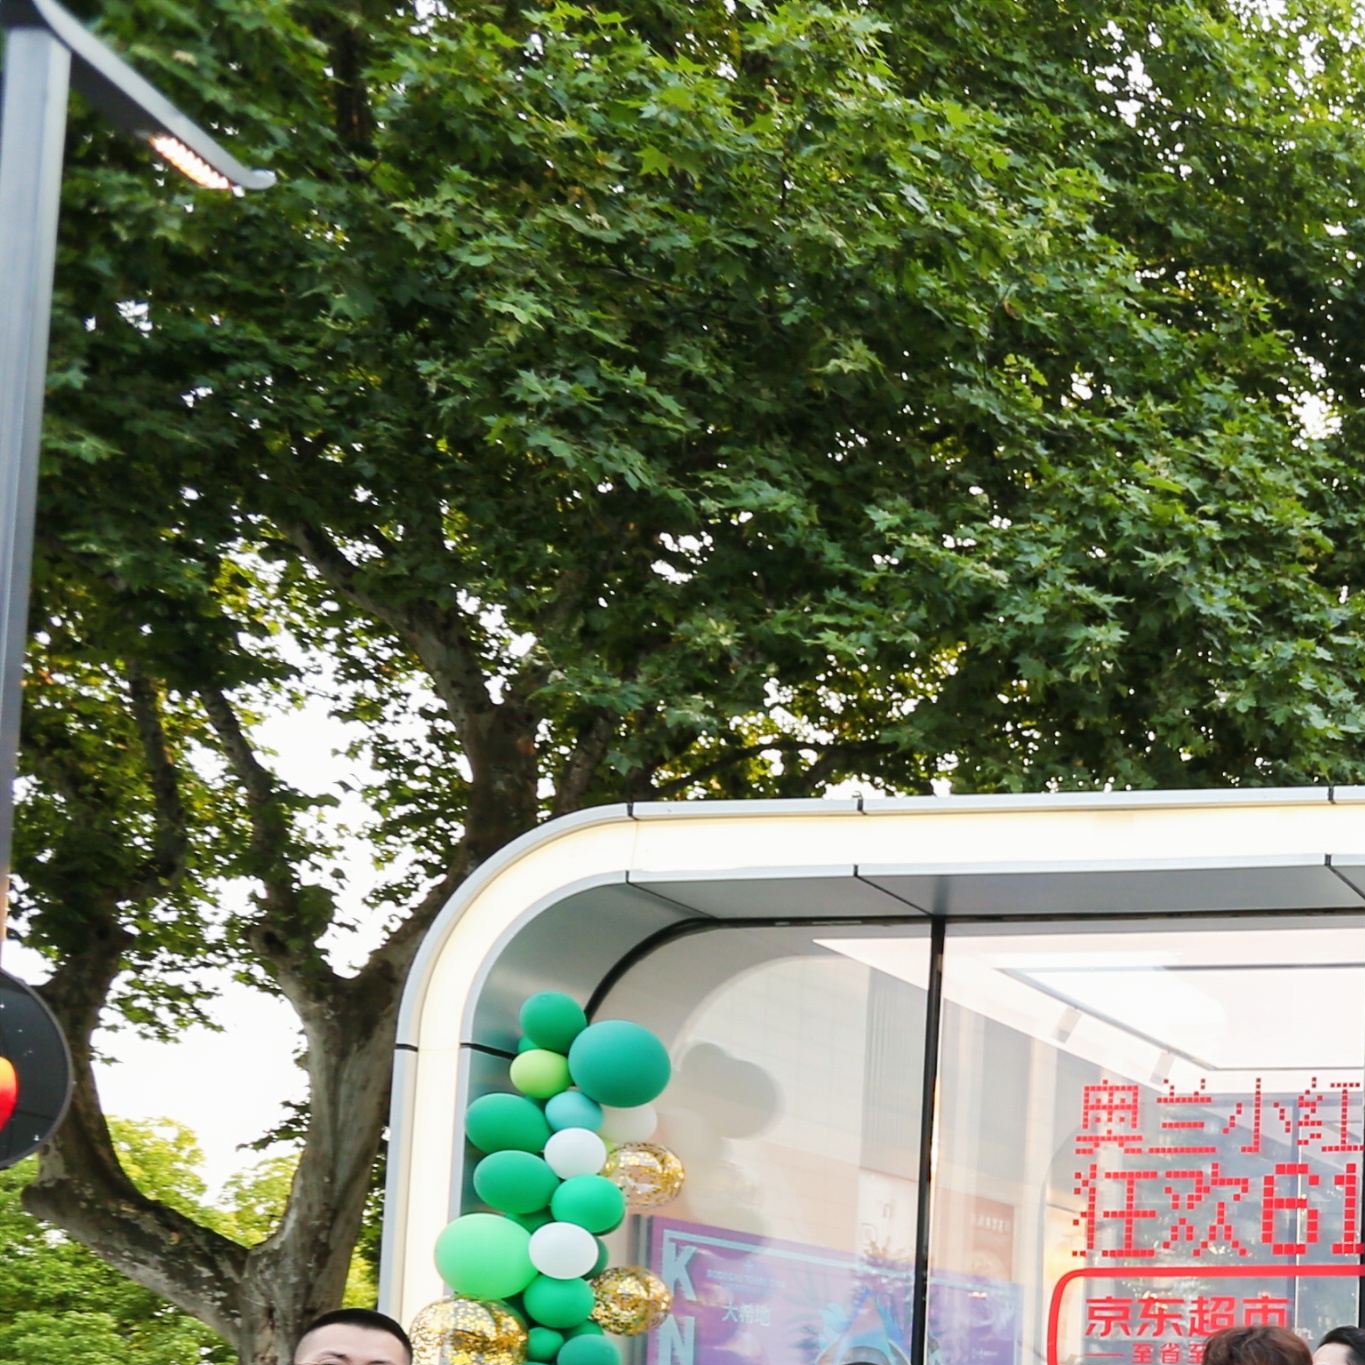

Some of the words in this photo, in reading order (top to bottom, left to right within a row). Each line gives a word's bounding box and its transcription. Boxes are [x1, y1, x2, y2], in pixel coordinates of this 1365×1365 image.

[1085, 1296, 1290, 1337] 京东超市
[1131, 1342, 1208, 1365] 至省至
